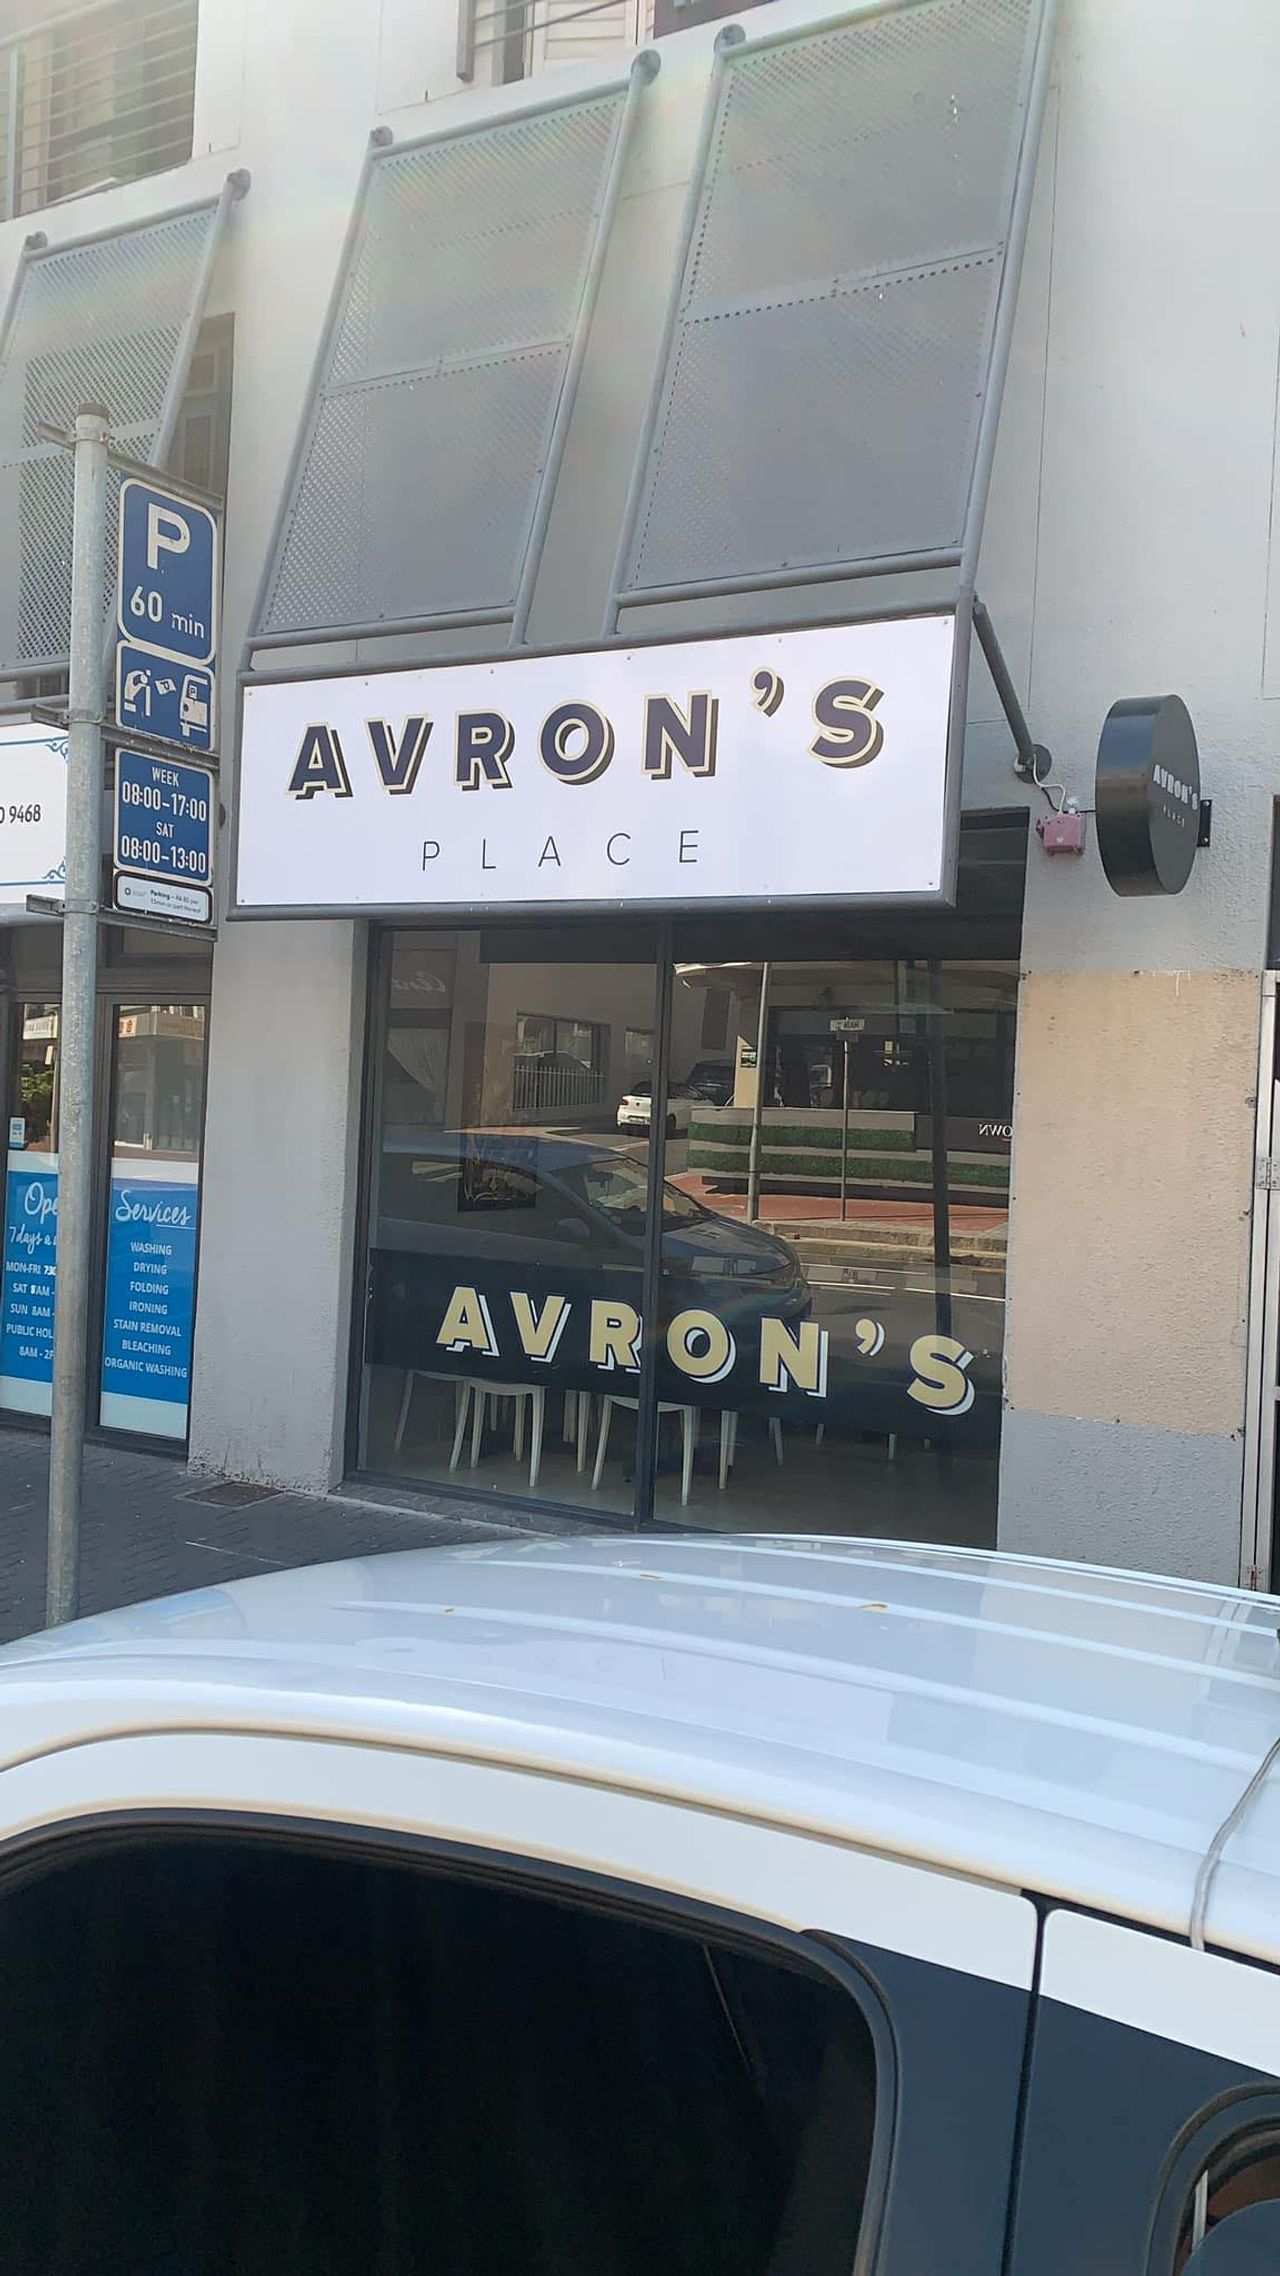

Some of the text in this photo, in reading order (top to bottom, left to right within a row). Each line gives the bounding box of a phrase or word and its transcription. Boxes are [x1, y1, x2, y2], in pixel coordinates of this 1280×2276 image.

[147, 502, 191, 570] P
[130, 585, 205, 639] 60 min
[284, 666, 885, 800] AVRON'S
[152, 766, 179, 787] WEEK
[1153, 764, 1198, 810] AVRON'S
[9, 803, 41, 824] 9468
[155, 821, 174, 838] SAT
[422, 829, 699, 872] PLACE
[25, 1182, 58, 1224] Ope
[115, 1189, 191, 1226] Services
[130, 1241, 172, 1256] WASHING
[6, 1261, 41, 1275] MON-FRI
[133, 1262, 167, 1275] DRYING
[12, 1282, 28, 1294] SAT
[130, 1281, 168, 1295] FOLDING
[10, 1303, 28, 1315] SUN
[129, 1301, 168, 1315] IRONING
[6, 1323, 54, 1339] PUBLIC HOL
[113, 1319, 182, 1337] STAIN REMOVAL
[121, 1339, 171, 1356] BLEACHING
[436, 1285, 974, 1416] AVRON'S
[104, 1356, 188, 1378] ORGANIC WASHING
